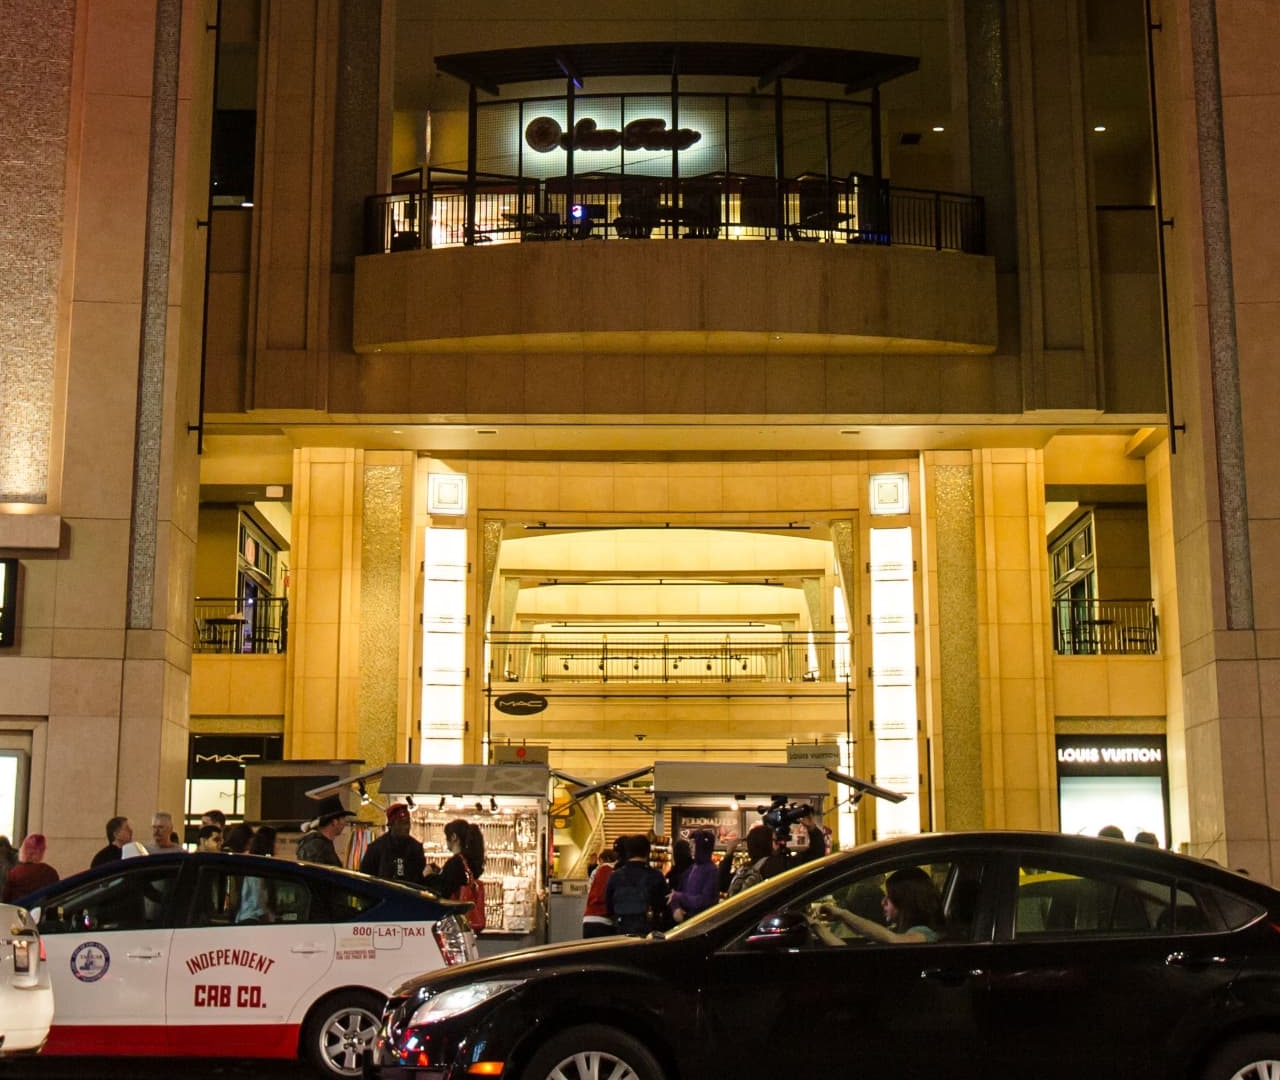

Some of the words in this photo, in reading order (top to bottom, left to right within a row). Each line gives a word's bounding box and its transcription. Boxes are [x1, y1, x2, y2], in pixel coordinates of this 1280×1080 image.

[1058, 748, 1100, 762] LOUIS
[1100, 748, 1162, 762] VUITTON
[185, 948, 276, 975] INDEPENDENT
[194, 984, 232, 1007] CAB
[237, 985, 267, 1008] CO.
